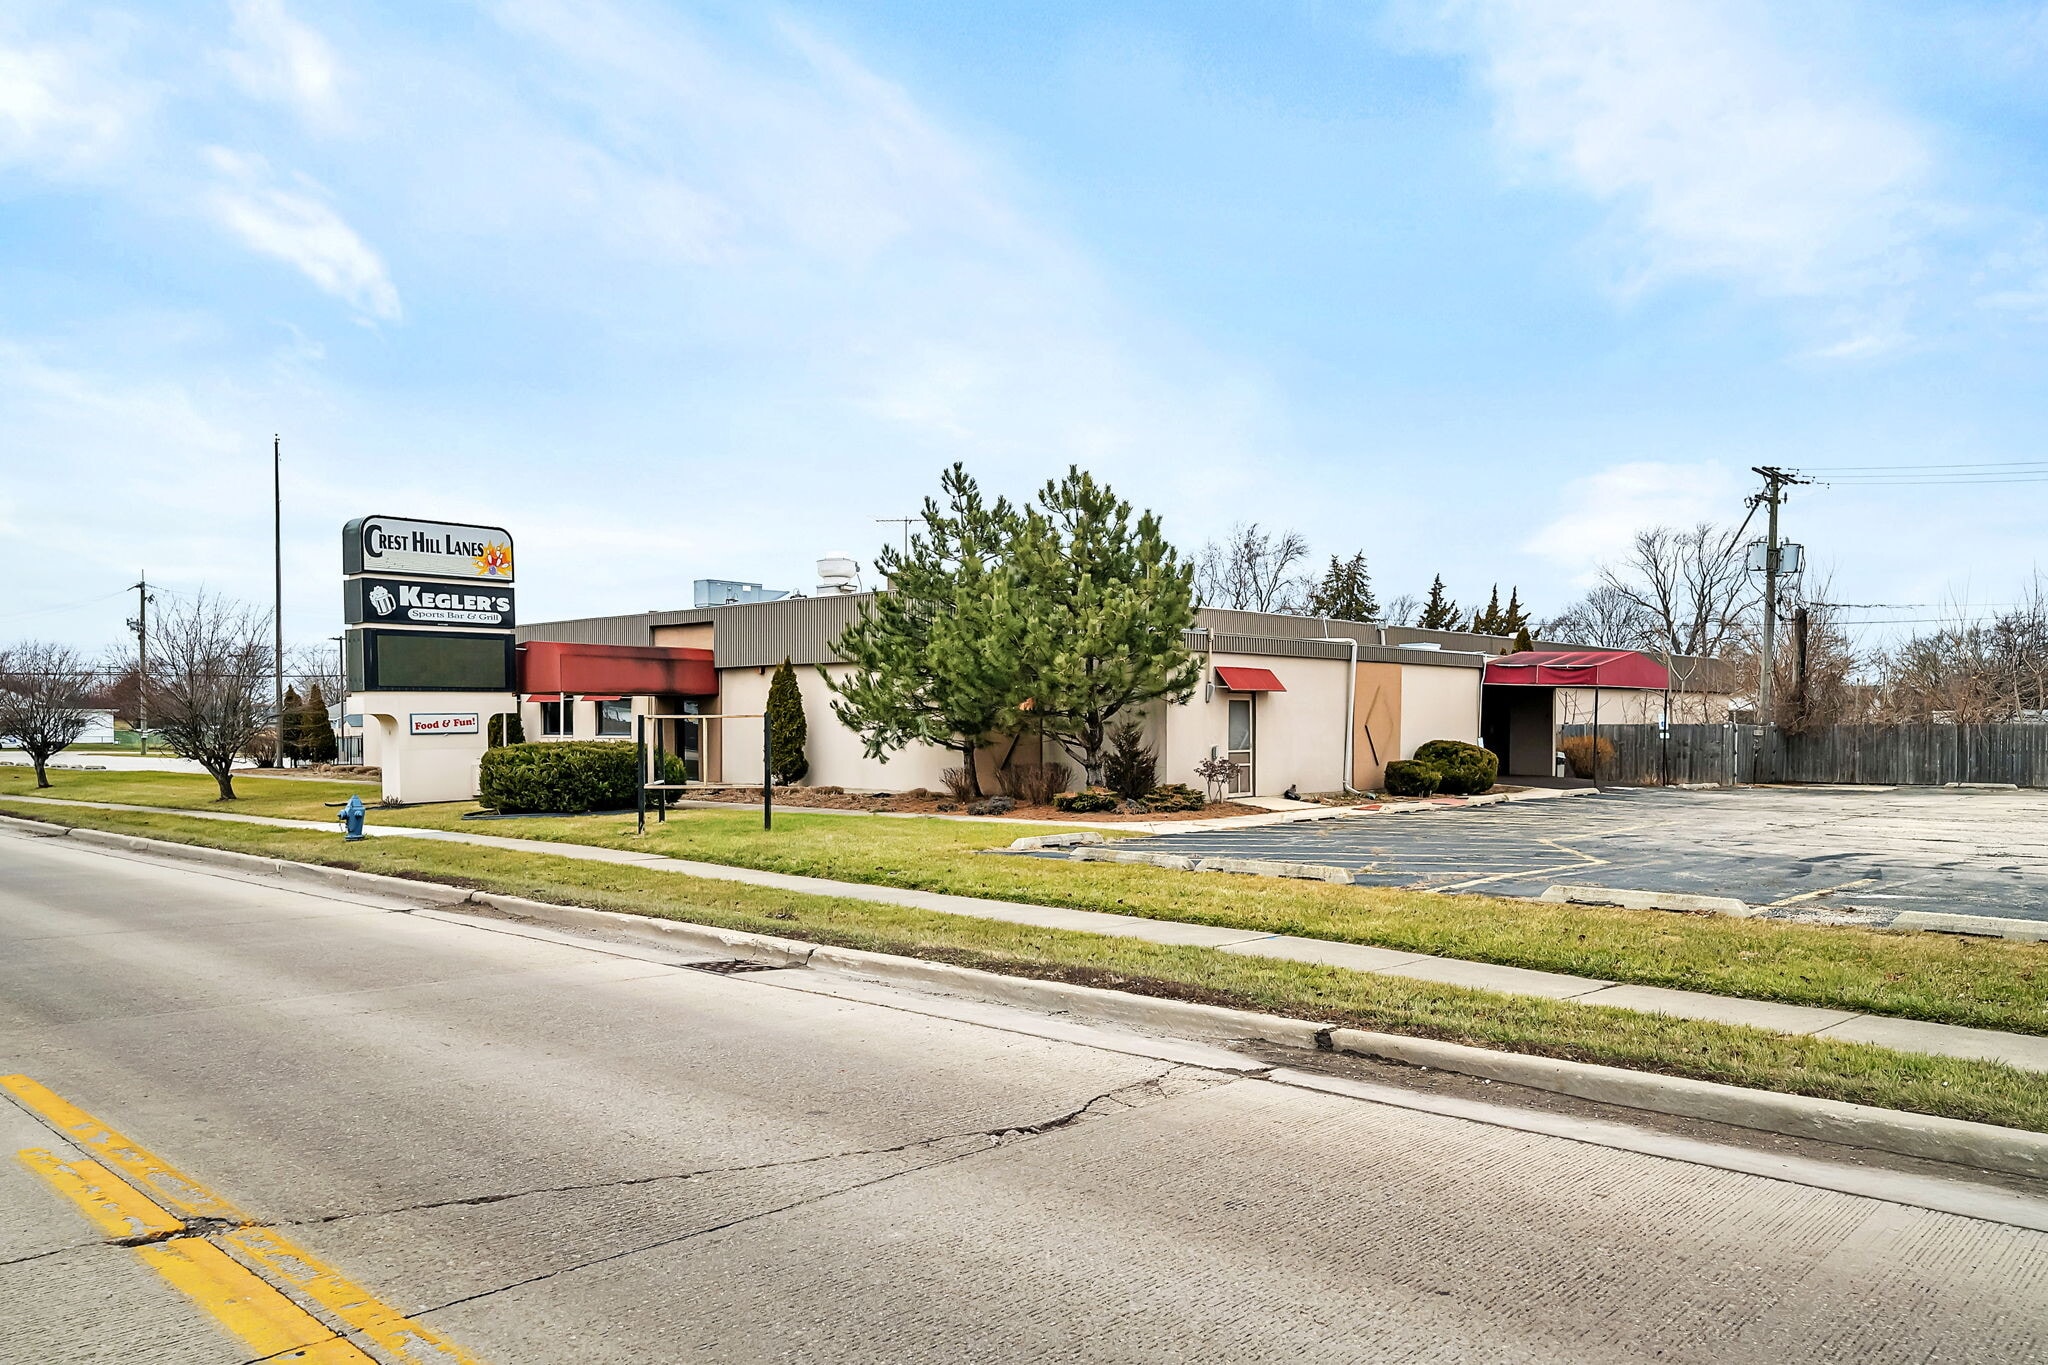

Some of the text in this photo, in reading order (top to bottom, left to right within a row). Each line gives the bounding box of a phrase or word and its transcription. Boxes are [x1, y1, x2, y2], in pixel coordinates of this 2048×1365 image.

[412, 531, 442, 554] HILL
[445, 534, 484, 557] LANES
[399, 585, 510, 612] KEGLER'S
[412, 610, 444, 618] Sports
[479, 613, 499, 621] Grill
[415, 721, 439, 730] Food
[453, 717, 476, 727] Fun!
